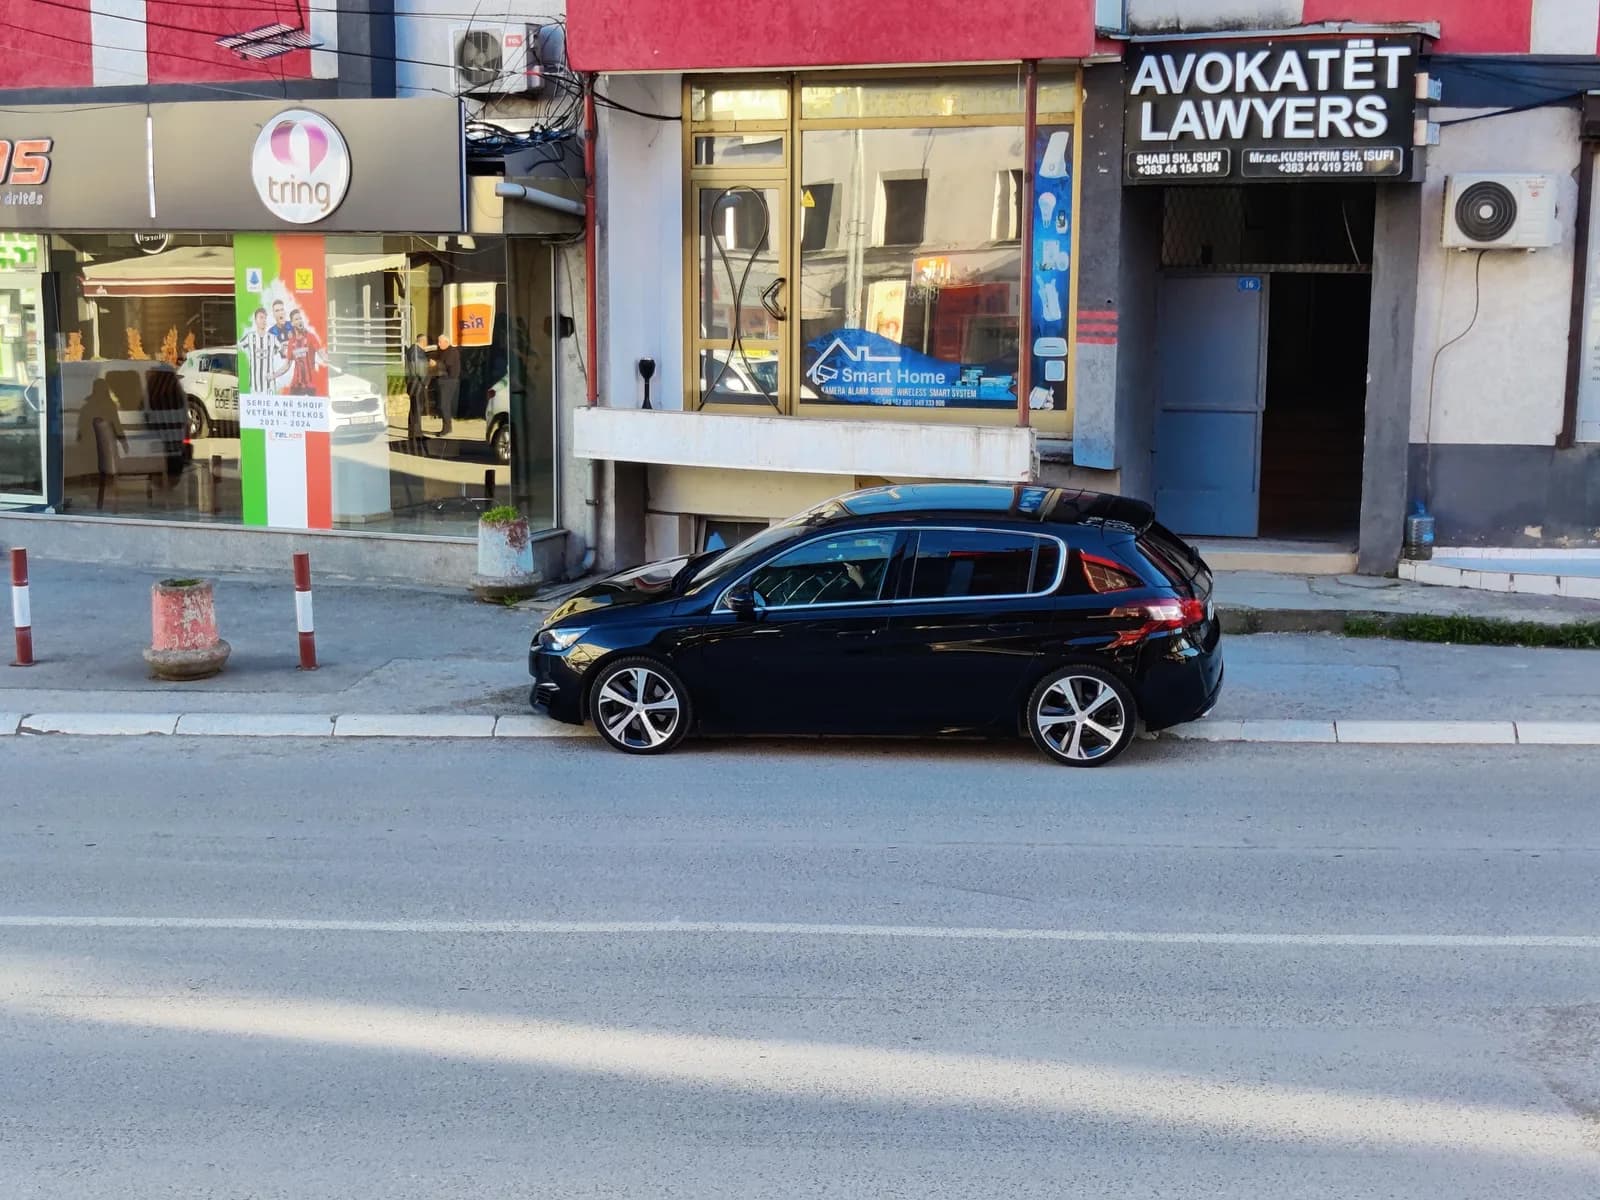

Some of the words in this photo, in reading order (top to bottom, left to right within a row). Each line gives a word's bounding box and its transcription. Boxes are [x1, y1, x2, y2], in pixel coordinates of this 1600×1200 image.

[1130, 39, 1411, 95] AVOKATËT
[1140, 95, 1388, 141] LAWYERS
[1136, 153, 1171, 165] SHABI
[1172, 152, 1190, 163] SH.
[1193, 151, 1221, 162] ISUFI
[1342, 151, 1361, 161] SH.
[1364, 150, 1394, 161] ISUFI
[1138, 164, 1163, 175] +383
[1164, 164, 1178, 174] 44
[1180, 163, 1199, 174] 154
[1278, 163, 1304, 173] +383
[1306, 163, 1320, 172] 44
[1321, 162, 1341, 172] 419
[268, 174, 331, 212] tring
[842, 368, 892, 383] Smart
[897, 369, 945, 384] Home
[847, 387, 868, 395] ALARM
[897, 388, 926, 397] WIRELESS
[929, 388, 950, 397] SMART
[951, 388, 977, 398] SYSTEM
[246, 408, 274, 416] VETËM
[292, 410, 324, 419] TELKOS
